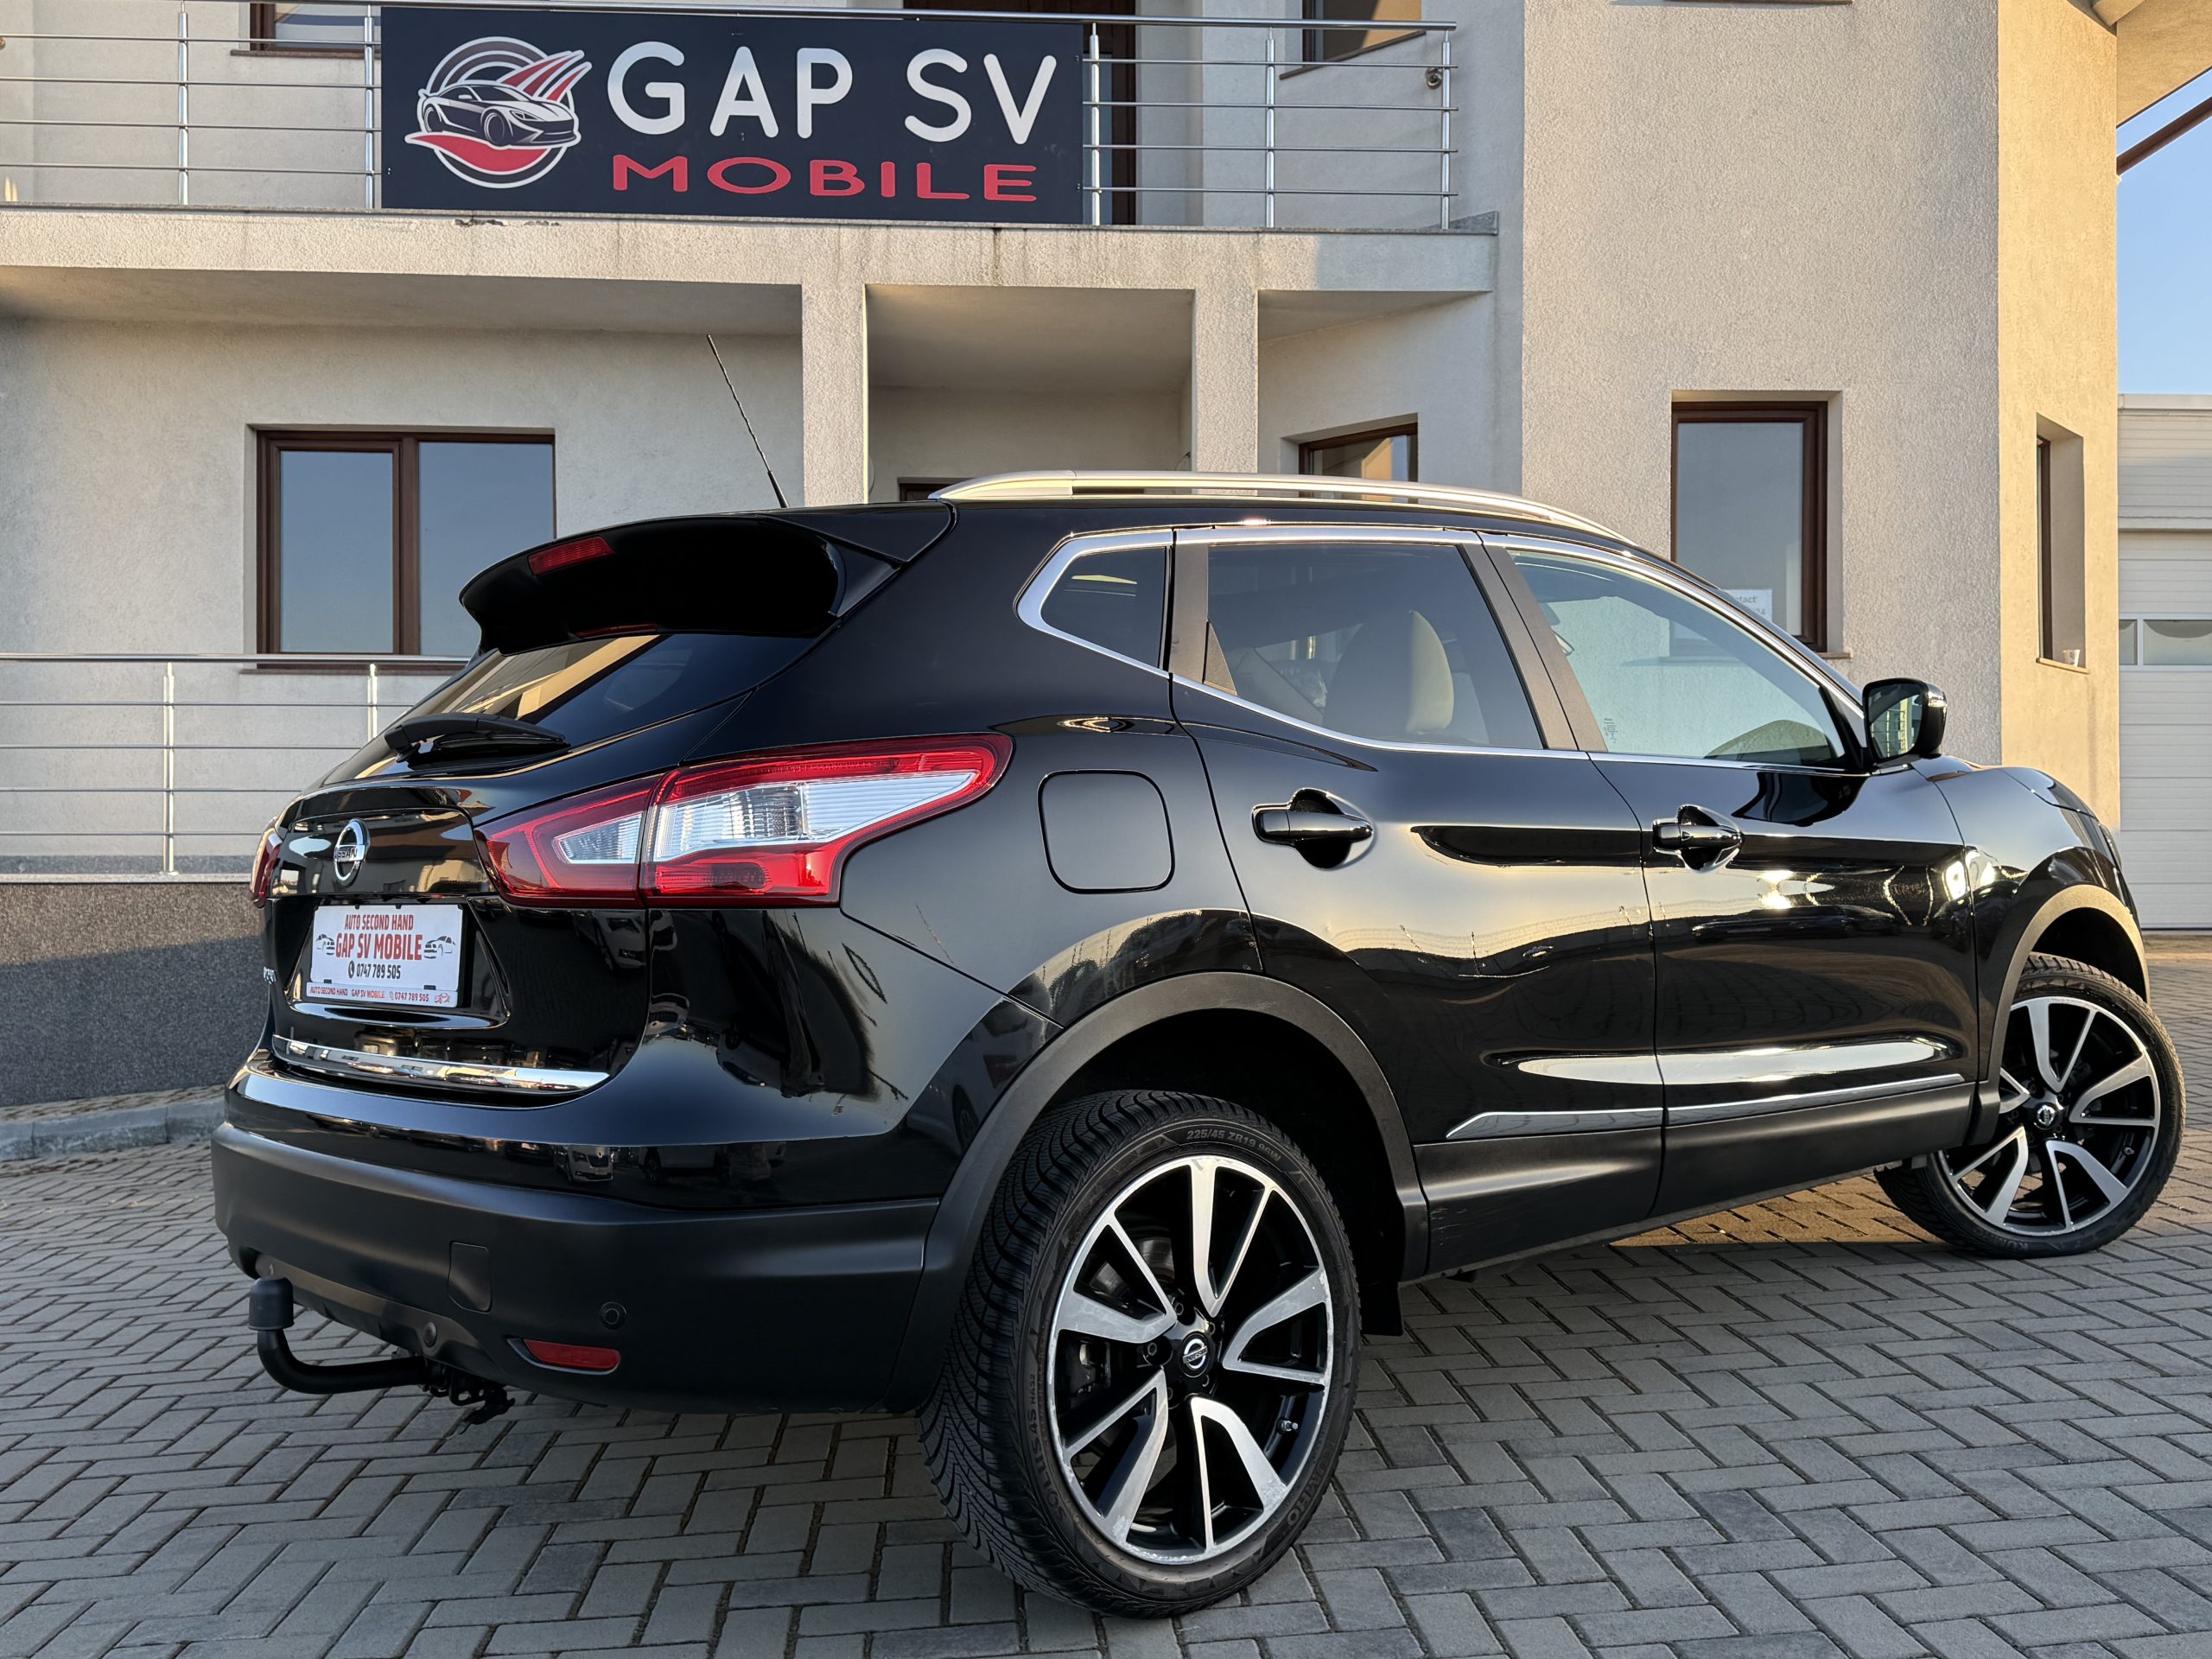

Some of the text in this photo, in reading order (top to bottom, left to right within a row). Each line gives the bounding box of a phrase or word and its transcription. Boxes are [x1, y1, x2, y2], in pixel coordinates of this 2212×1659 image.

[607, 41, 1057, 145] GAP SV
[613, 154, 1038, 202] MOBILE
[345, 914, 414, 931] AUTO SECOND HAND
[335, 933, 423, 961] GAP SV MOBILE
[356, 963, 402, 980] 0747 789 505
[321, 987, 336, 995] SECOND
[351, 988, 360, 997] GAP
[360, 989, 366, 998] SV
[366, 990, 385, 999] MOBILE
[394, 993, 408, 1001] 0747
[408, 993, 419, 1002] 789
[419, 994, 429, 1002] 505
[1186, 1128, 1282, 1162] 225/45 ZR19 96W
[1027, 1408, 1039, 1435] 4S
